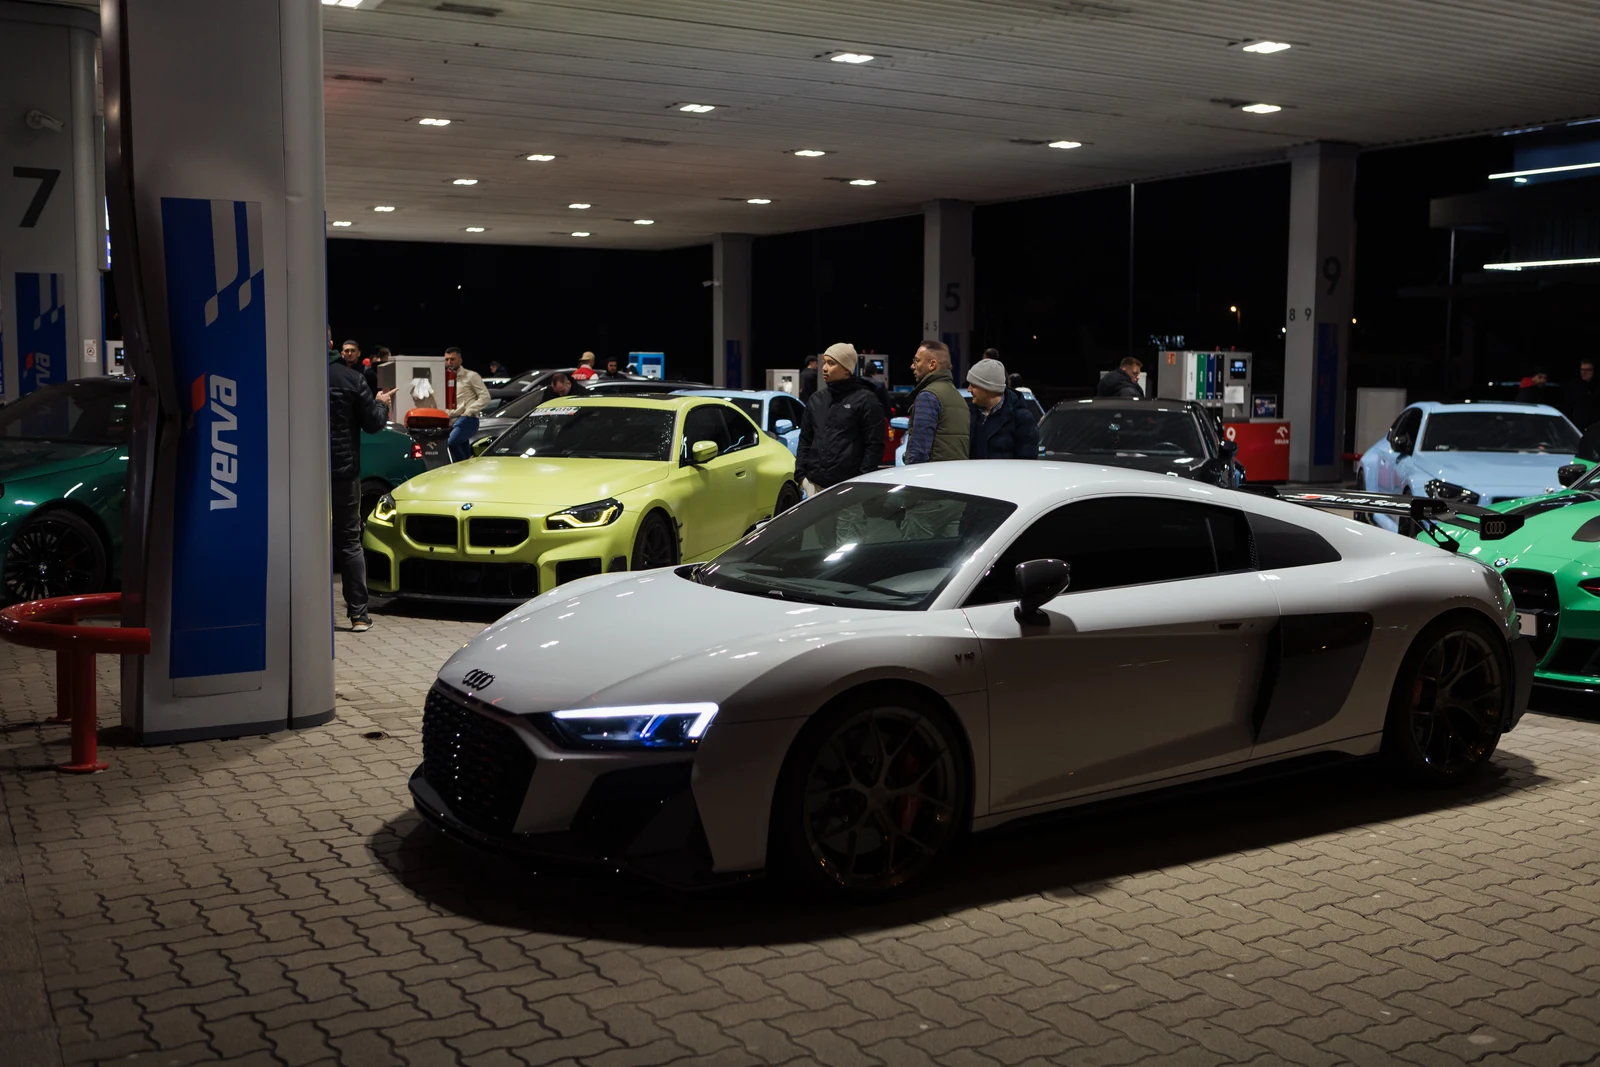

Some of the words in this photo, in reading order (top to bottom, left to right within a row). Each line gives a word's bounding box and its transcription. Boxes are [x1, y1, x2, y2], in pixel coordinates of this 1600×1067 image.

[13, 166, 61, 228] 7
[1322, 256, 1342, 296] 9
[945, 283, 961, 312] 5
[1289, 308, 1296, 321] 8
[1305, 308, 1312, 321] 9
[209, 374, 238, 511] verva
[1226, 426, 1236, 442] 9
[1320, 495, 1370, 504] Audi
[1369, 499, 1412, 509] Spo
